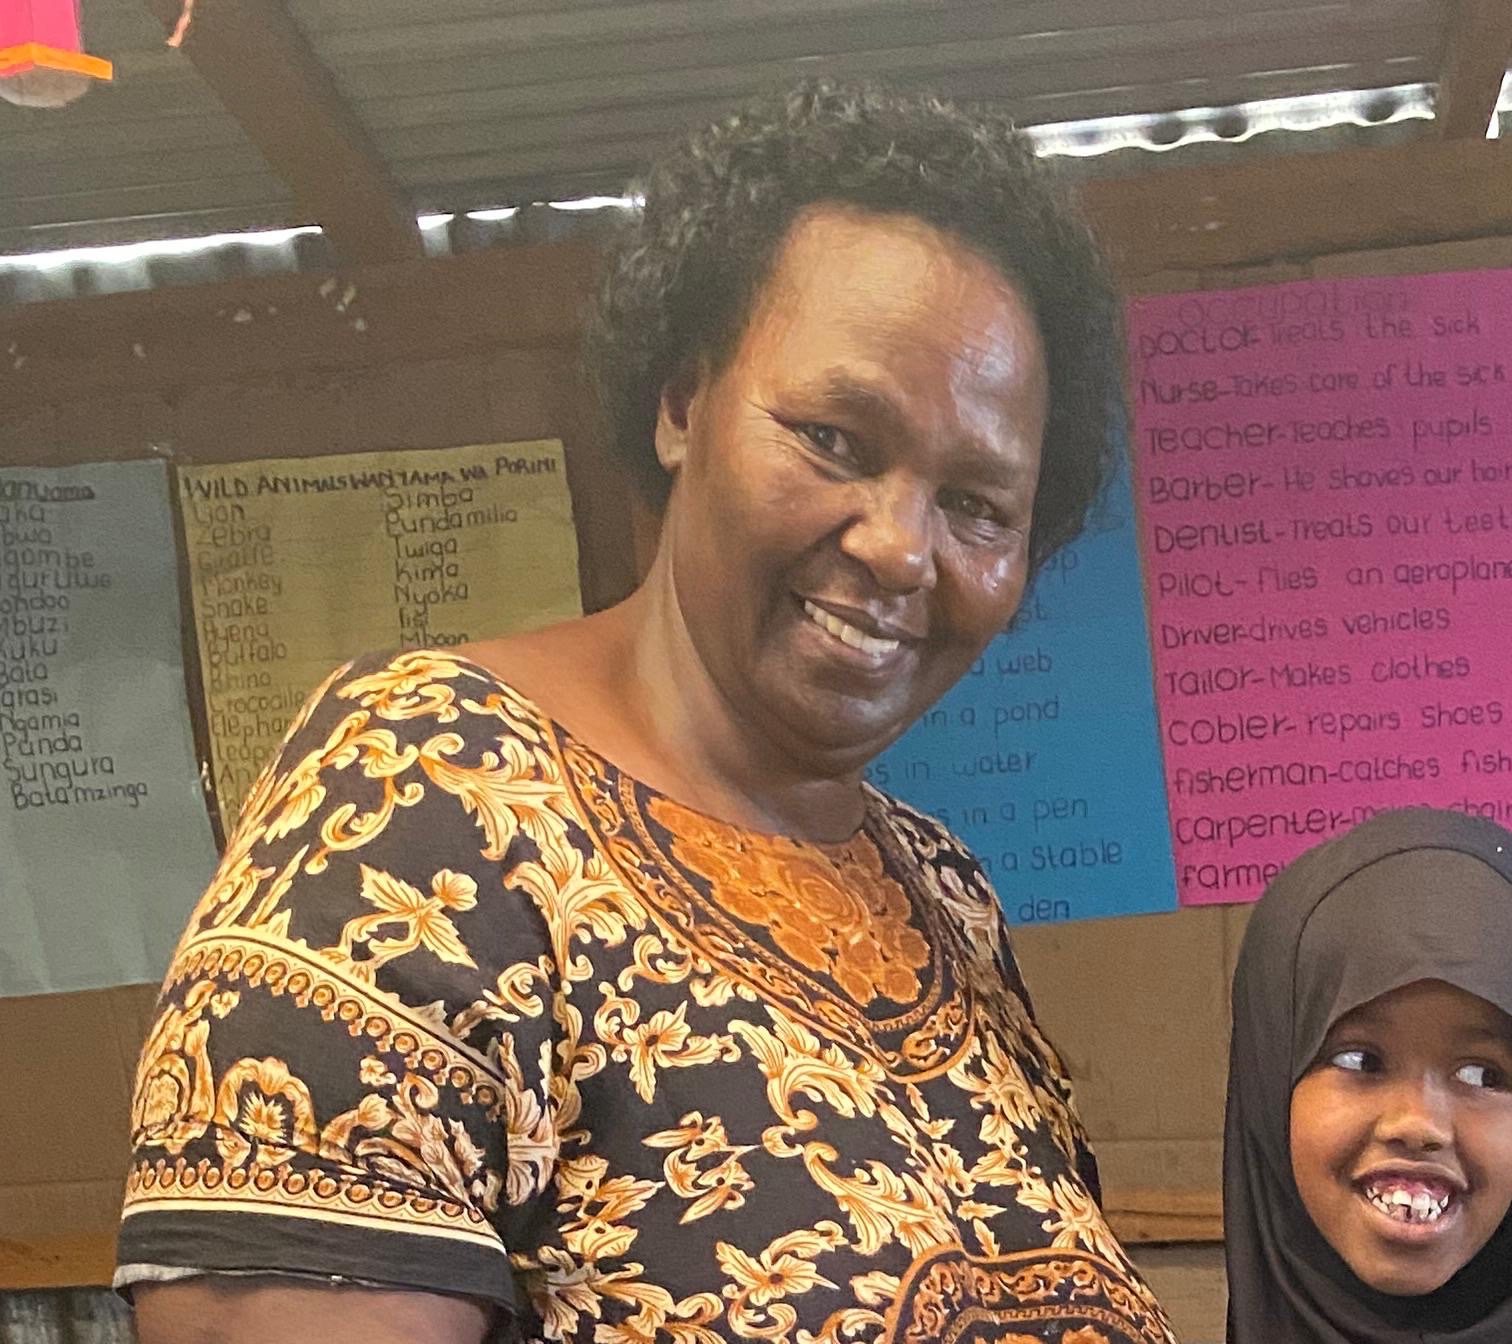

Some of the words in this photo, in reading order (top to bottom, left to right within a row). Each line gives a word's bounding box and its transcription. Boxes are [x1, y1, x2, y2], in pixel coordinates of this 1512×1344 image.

[1365, 312, 1412, 339] the
[1406, 361, 1446, 388] the
[1413, 408, 1493, 450] pupils
[184, 476, 249, 499] WILD
[1423, 467, 1462, 486] our
[1386, 513, 1431, 534] our
[1346, 566, 1383, 586] an
[1343, 606, 1450, 635] vehicles
[996, 647, 1052, 675] web
[959, 705, 976, 727] a
[994, 695, 1060, 741] pond
[3, 756, 114, 790] Sungura
[904, 758, 931, 781] in
[952, 750, 1039, 779] water
[1461, 749, 1512, 774] fish
[963, 808, 988, 827] in
[1001, 803, 1017, 823] a
[1032, 797, 1090, 834] pen
[1001, 850, 1020, 874] a
[1183, 861, 1286, 890] farme
[1018, 896, 1072, 923] den
